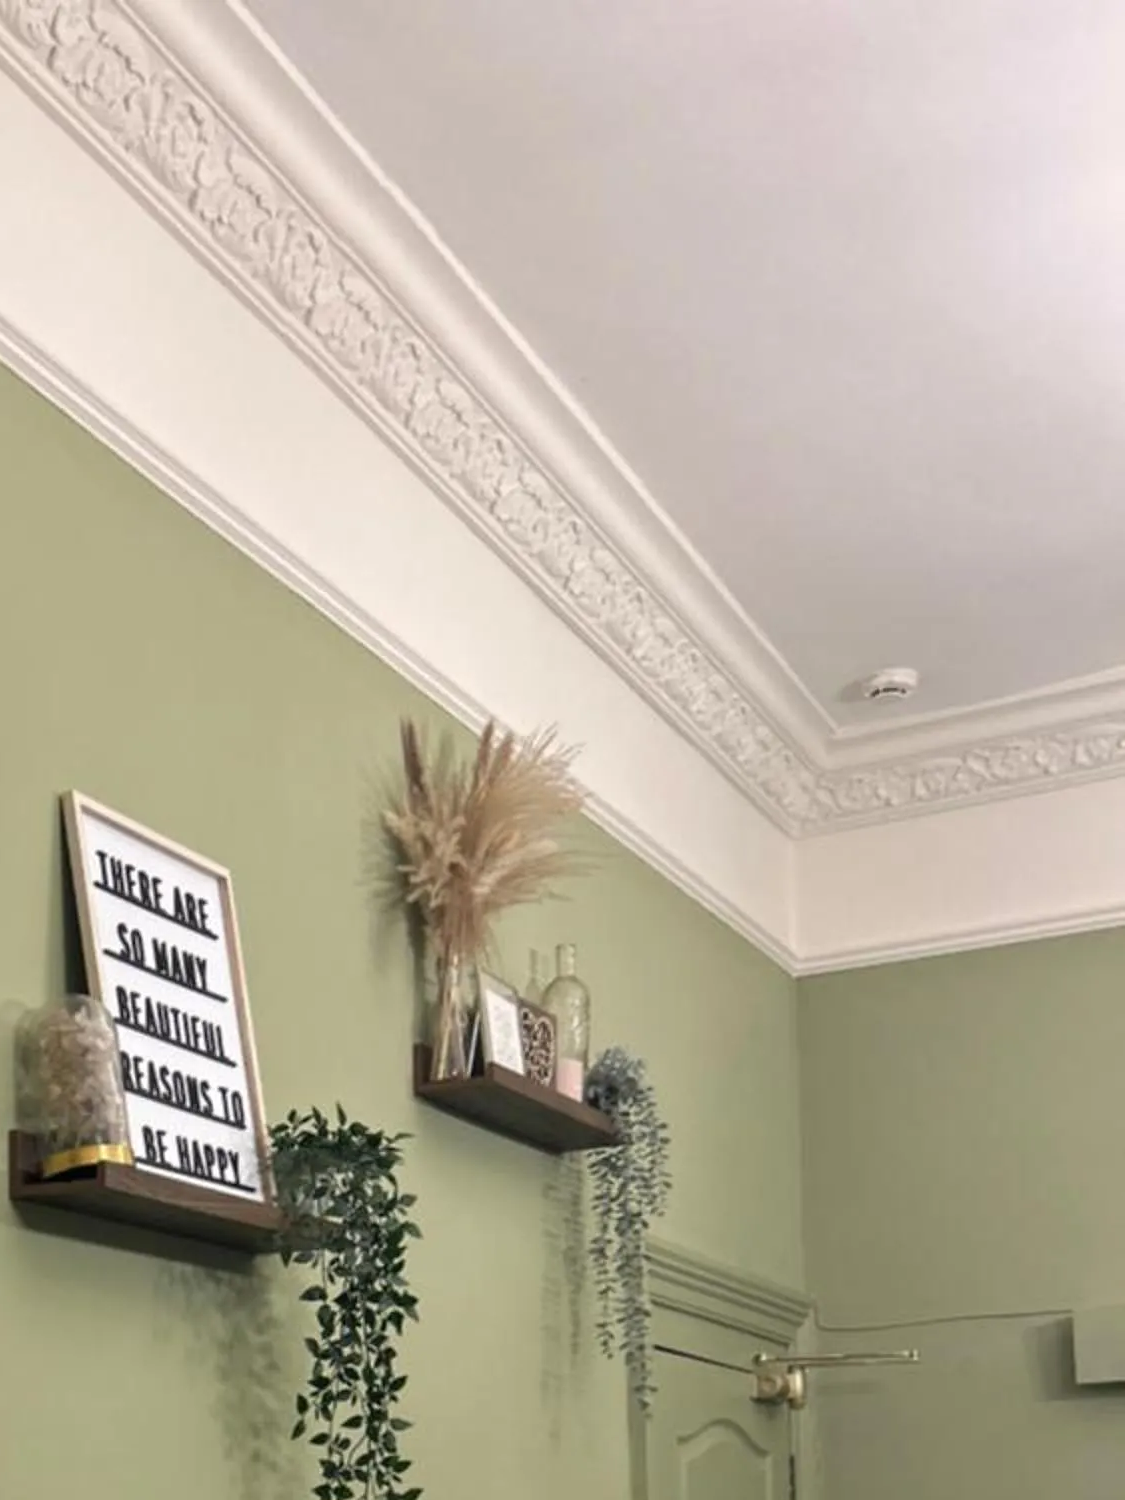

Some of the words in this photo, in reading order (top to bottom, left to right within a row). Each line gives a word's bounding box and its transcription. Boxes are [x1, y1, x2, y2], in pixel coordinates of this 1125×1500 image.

[95, 850, 164, 911] THERE
[173, 886, 209, 929] ARE
[117, 923, 145, 965] SO
[152, 938, 208, 990] MANY
[115, 985, 229, 1060] BEAUTIFUL
[120, 1051, 214, 1118] REASONS
[218, 1086, 245, 1128] TO
[142, 1125, 169, 1166] BE
[176, 1135, 241, 1185] HAPPY
